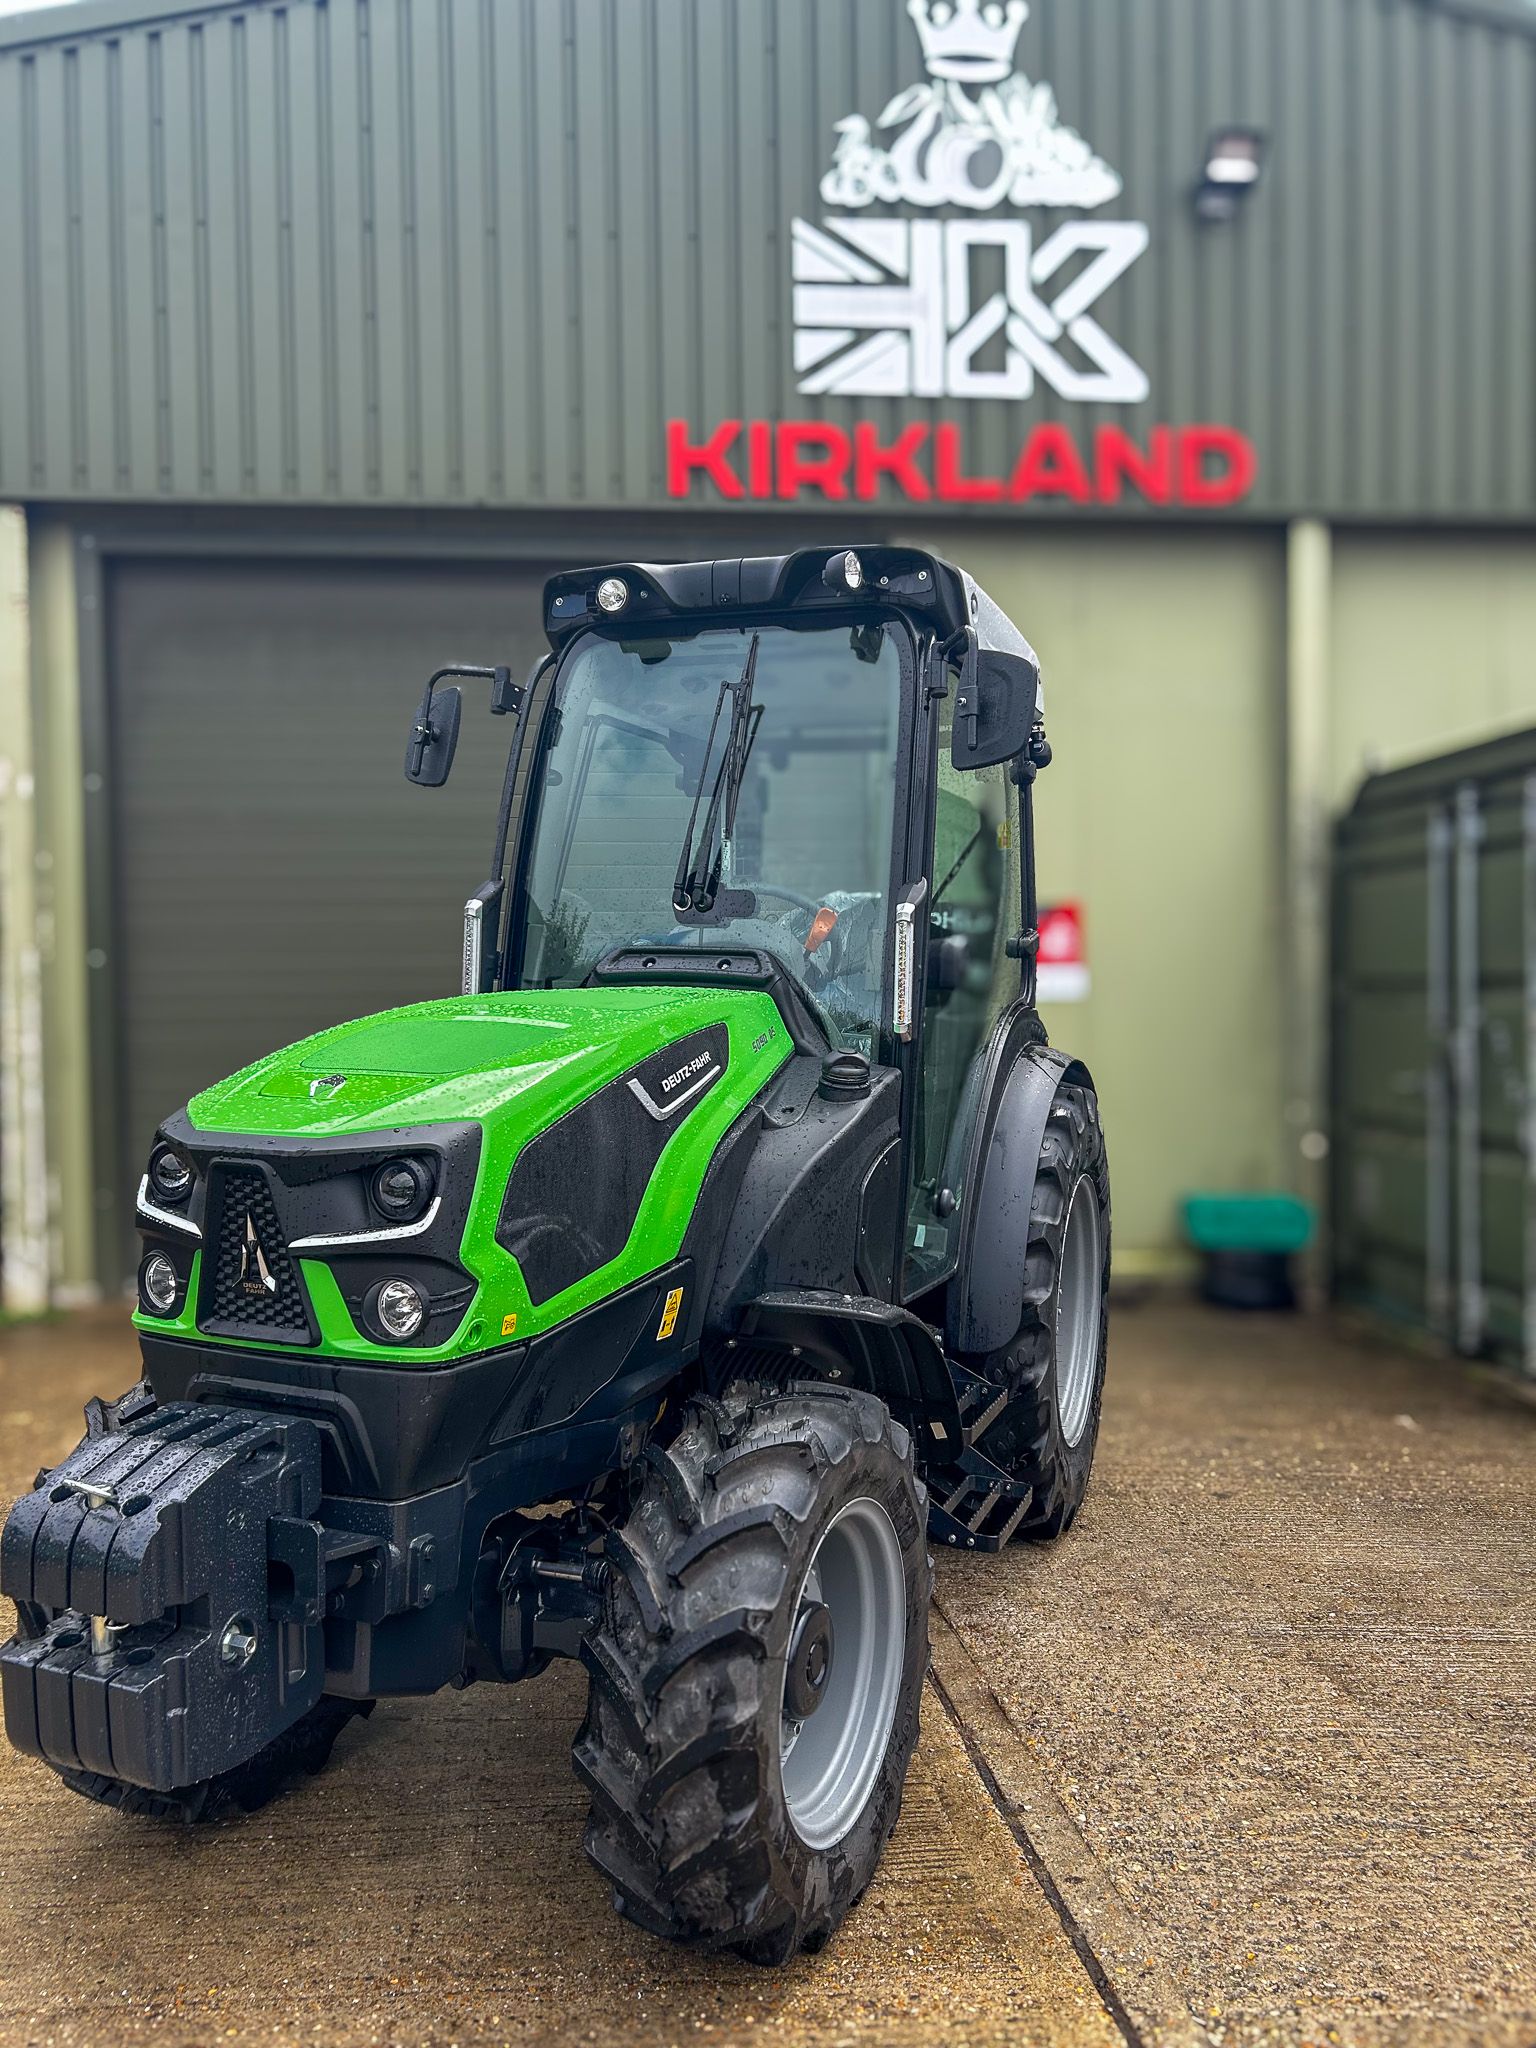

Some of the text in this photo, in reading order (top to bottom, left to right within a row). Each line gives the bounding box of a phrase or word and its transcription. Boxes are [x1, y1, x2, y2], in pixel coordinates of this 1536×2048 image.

[666, 419, 1256, 506] KIRKLAND
[243, 1282, 267, 1290] DEUTZ
[245, 1287, 266, 1295] FAHR
